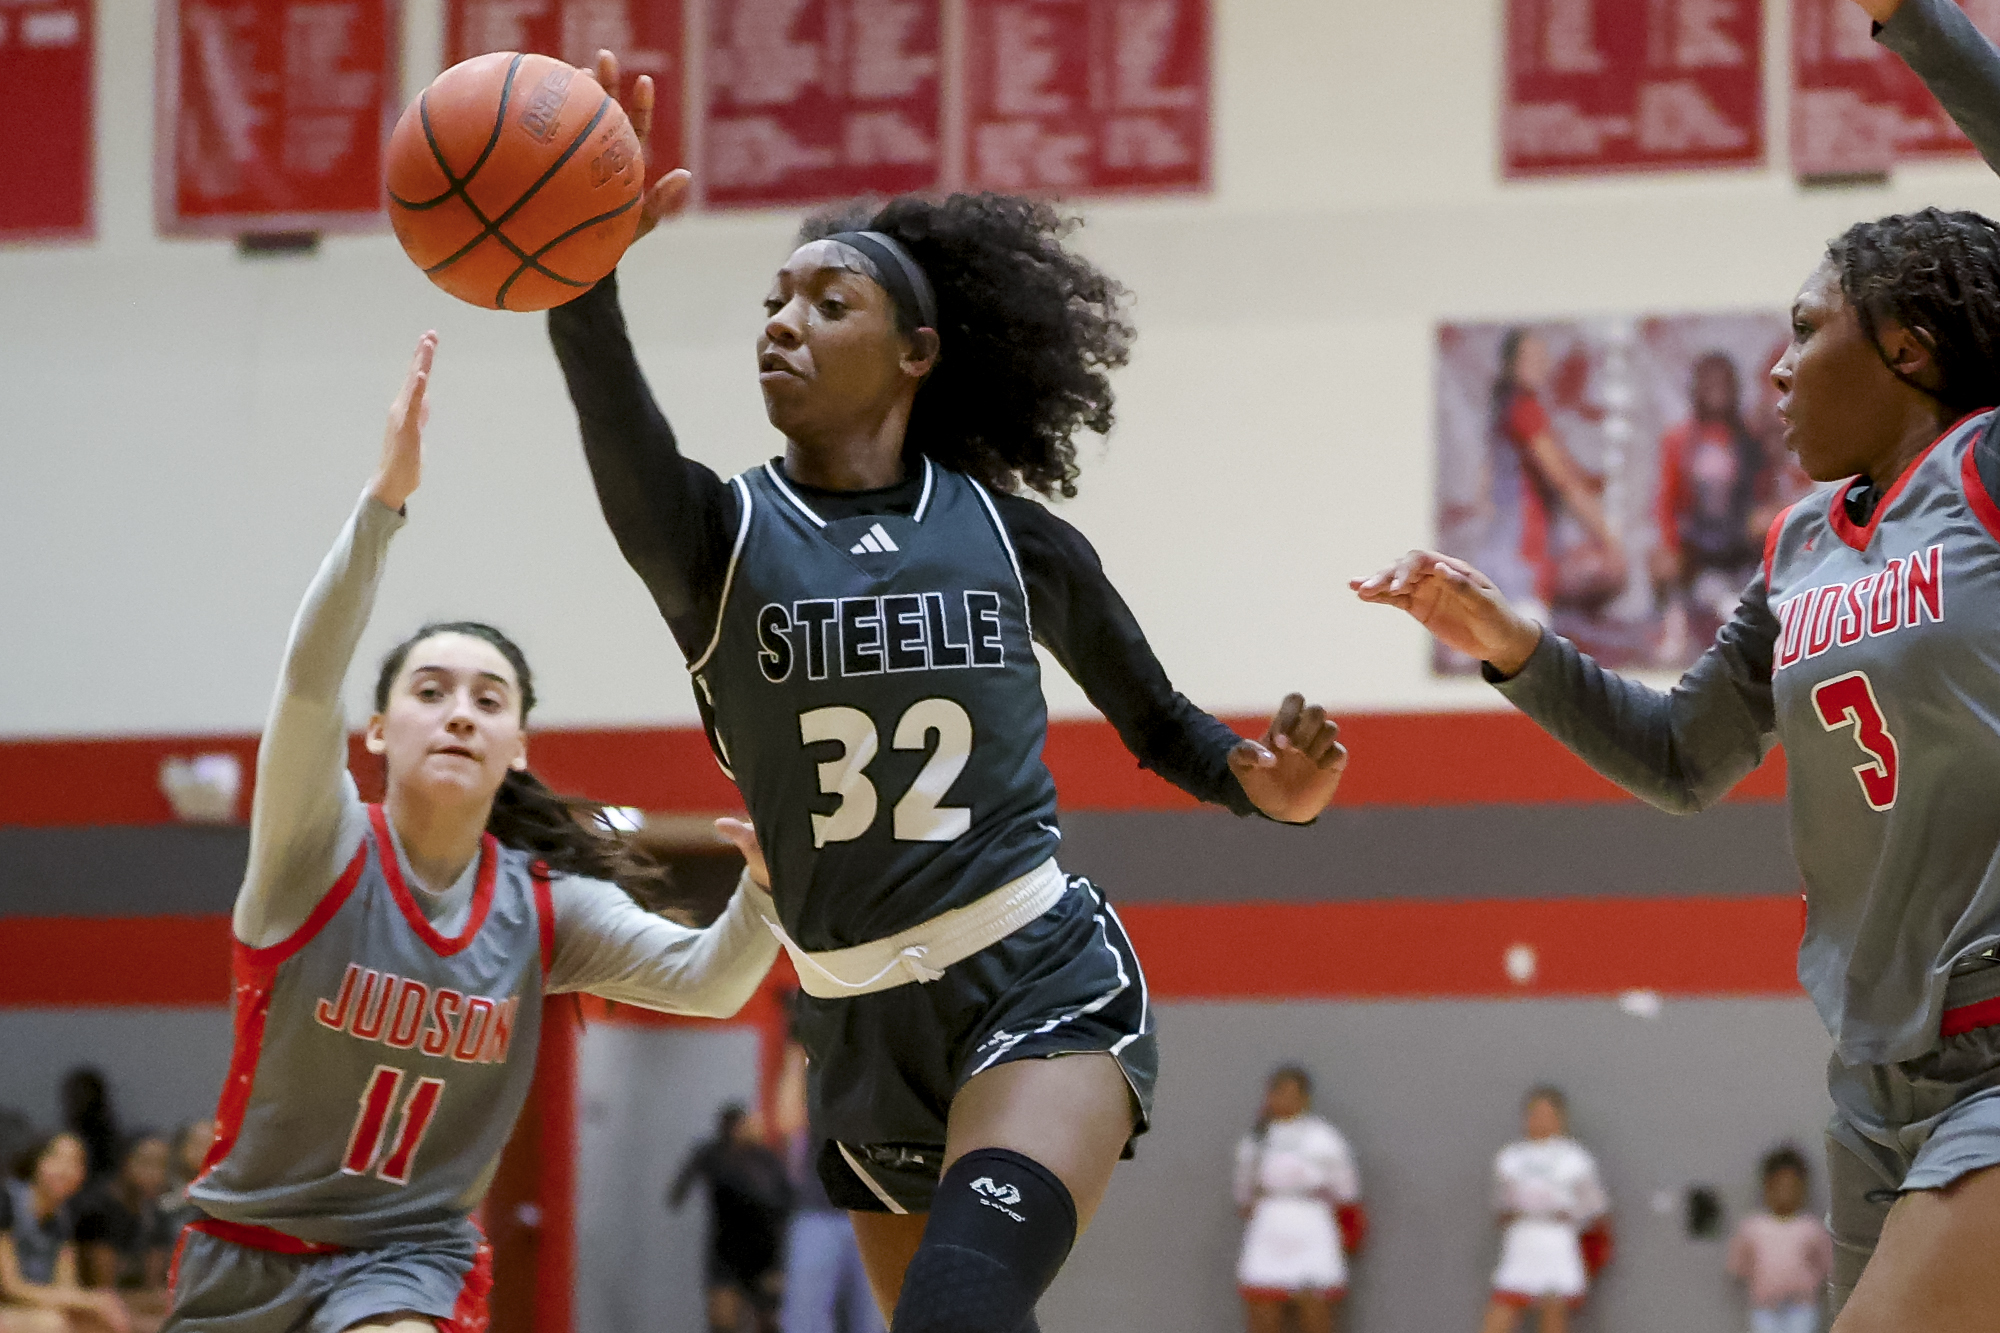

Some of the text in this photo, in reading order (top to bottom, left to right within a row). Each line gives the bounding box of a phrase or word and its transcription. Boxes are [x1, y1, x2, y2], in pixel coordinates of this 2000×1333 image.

[757, 590, 1005, 683] STEELE
[799, 698, 973, 849] 32
[1811, 670, 1899, 812] 3
[315, 962, 520, 1064] JUDSON
[341, 1064, 446, 1186] 11
